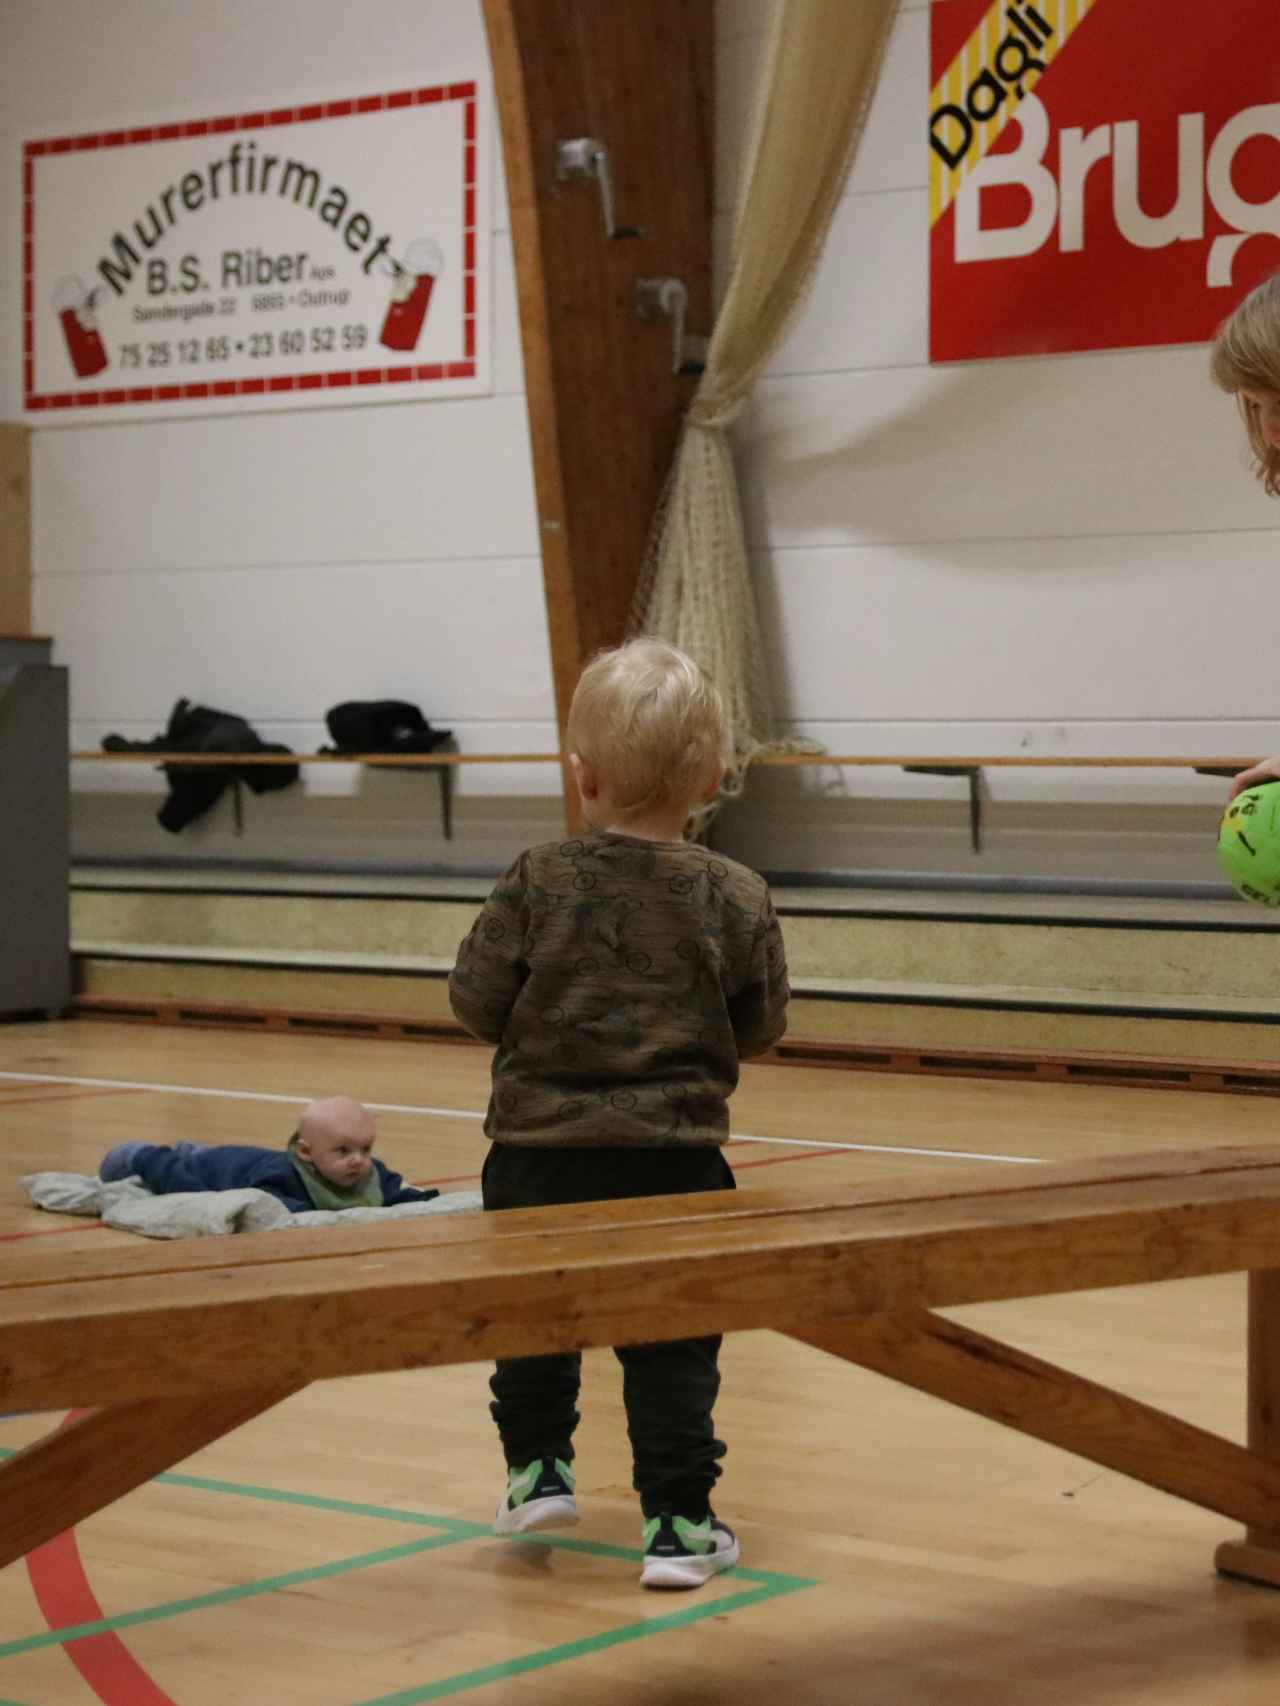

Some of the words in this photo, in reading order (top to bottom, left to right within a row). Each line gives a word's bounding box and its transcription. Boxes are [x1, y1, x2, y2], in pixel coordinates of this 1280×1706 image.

[97, 140, 391, 297] Murerfirmaet
[147, 253, 210, 296] B.S.
[221, 248, 308, 288] Riber
[148, 340, 170, 366] 25
[178, 338, 199, 364] 12
[250, 331, 274, 358] 23
[279, 328, 304, 355] 60
[310, 326, 335, 353] 52
